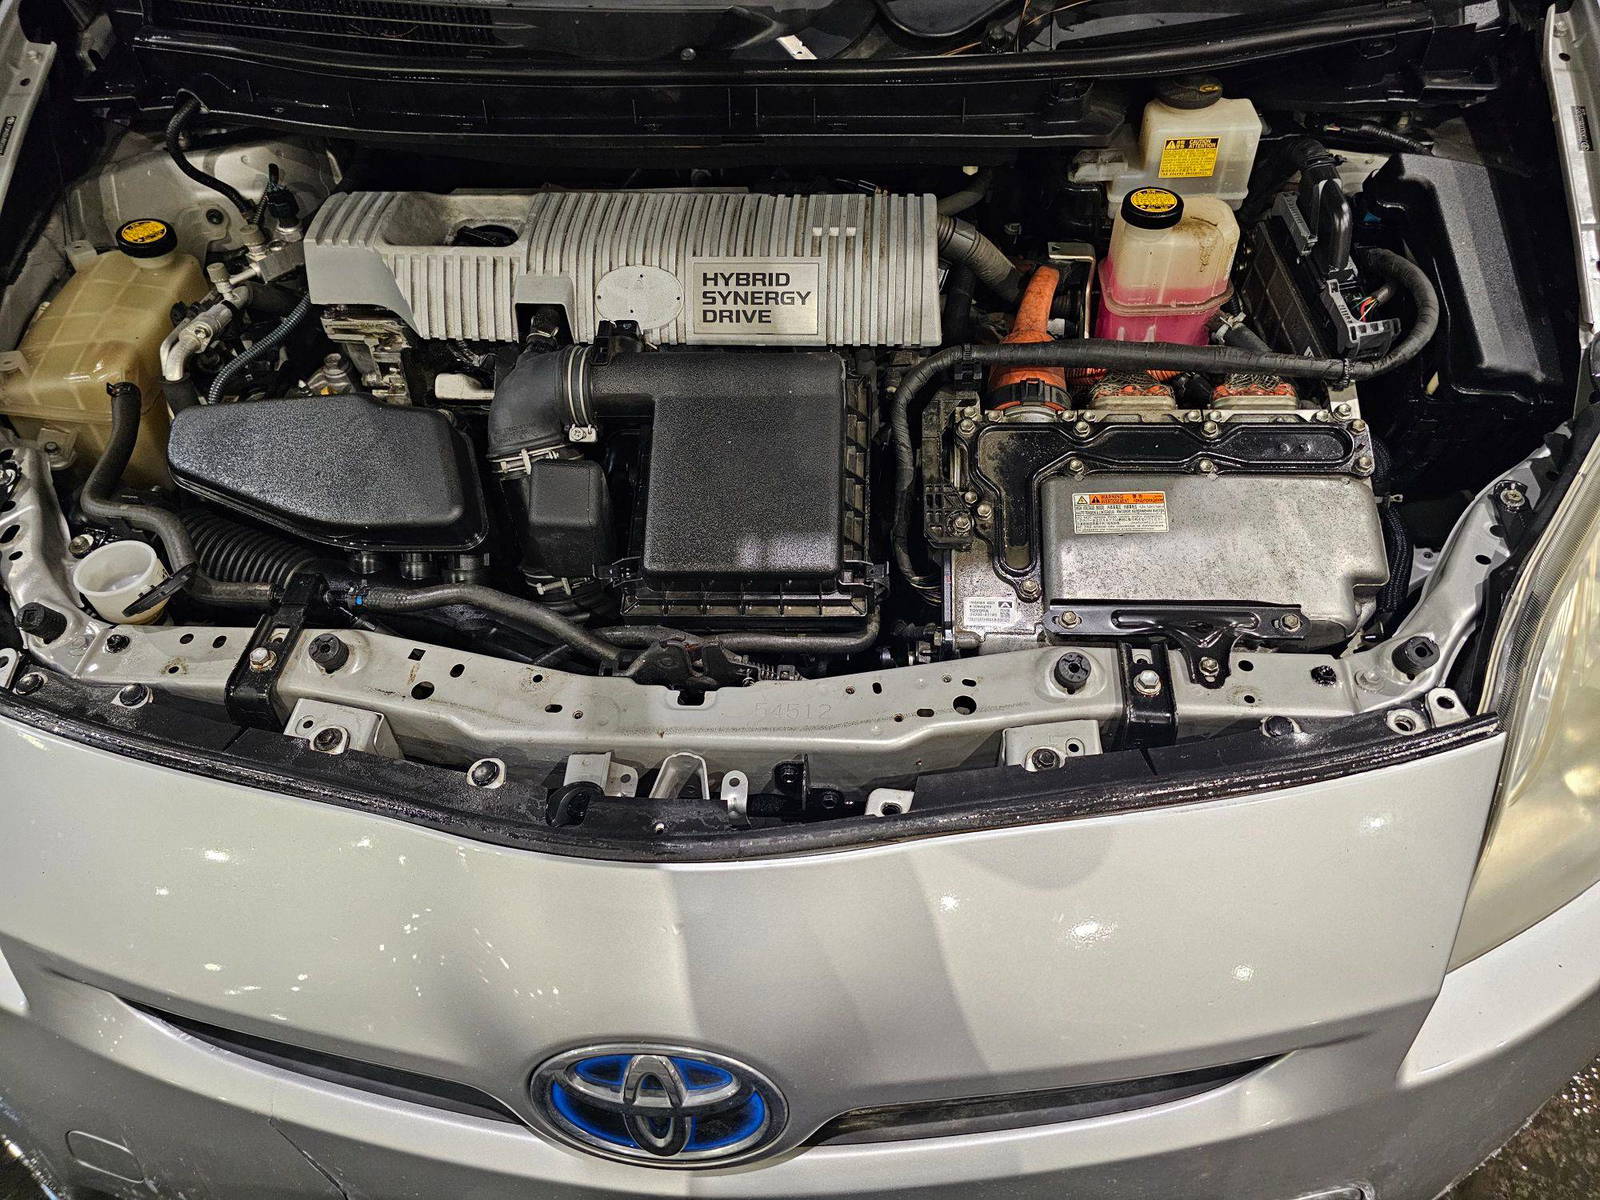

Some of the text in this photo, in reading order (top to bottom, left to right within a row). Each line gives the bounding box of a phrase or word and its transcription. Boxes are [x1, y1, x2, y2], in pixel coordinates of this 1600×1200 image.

[702, 272, 791, 287] HYBRID
[702, 290, 812, 306] SYNERGY
[702, 309, 772, 324] DRIVE
